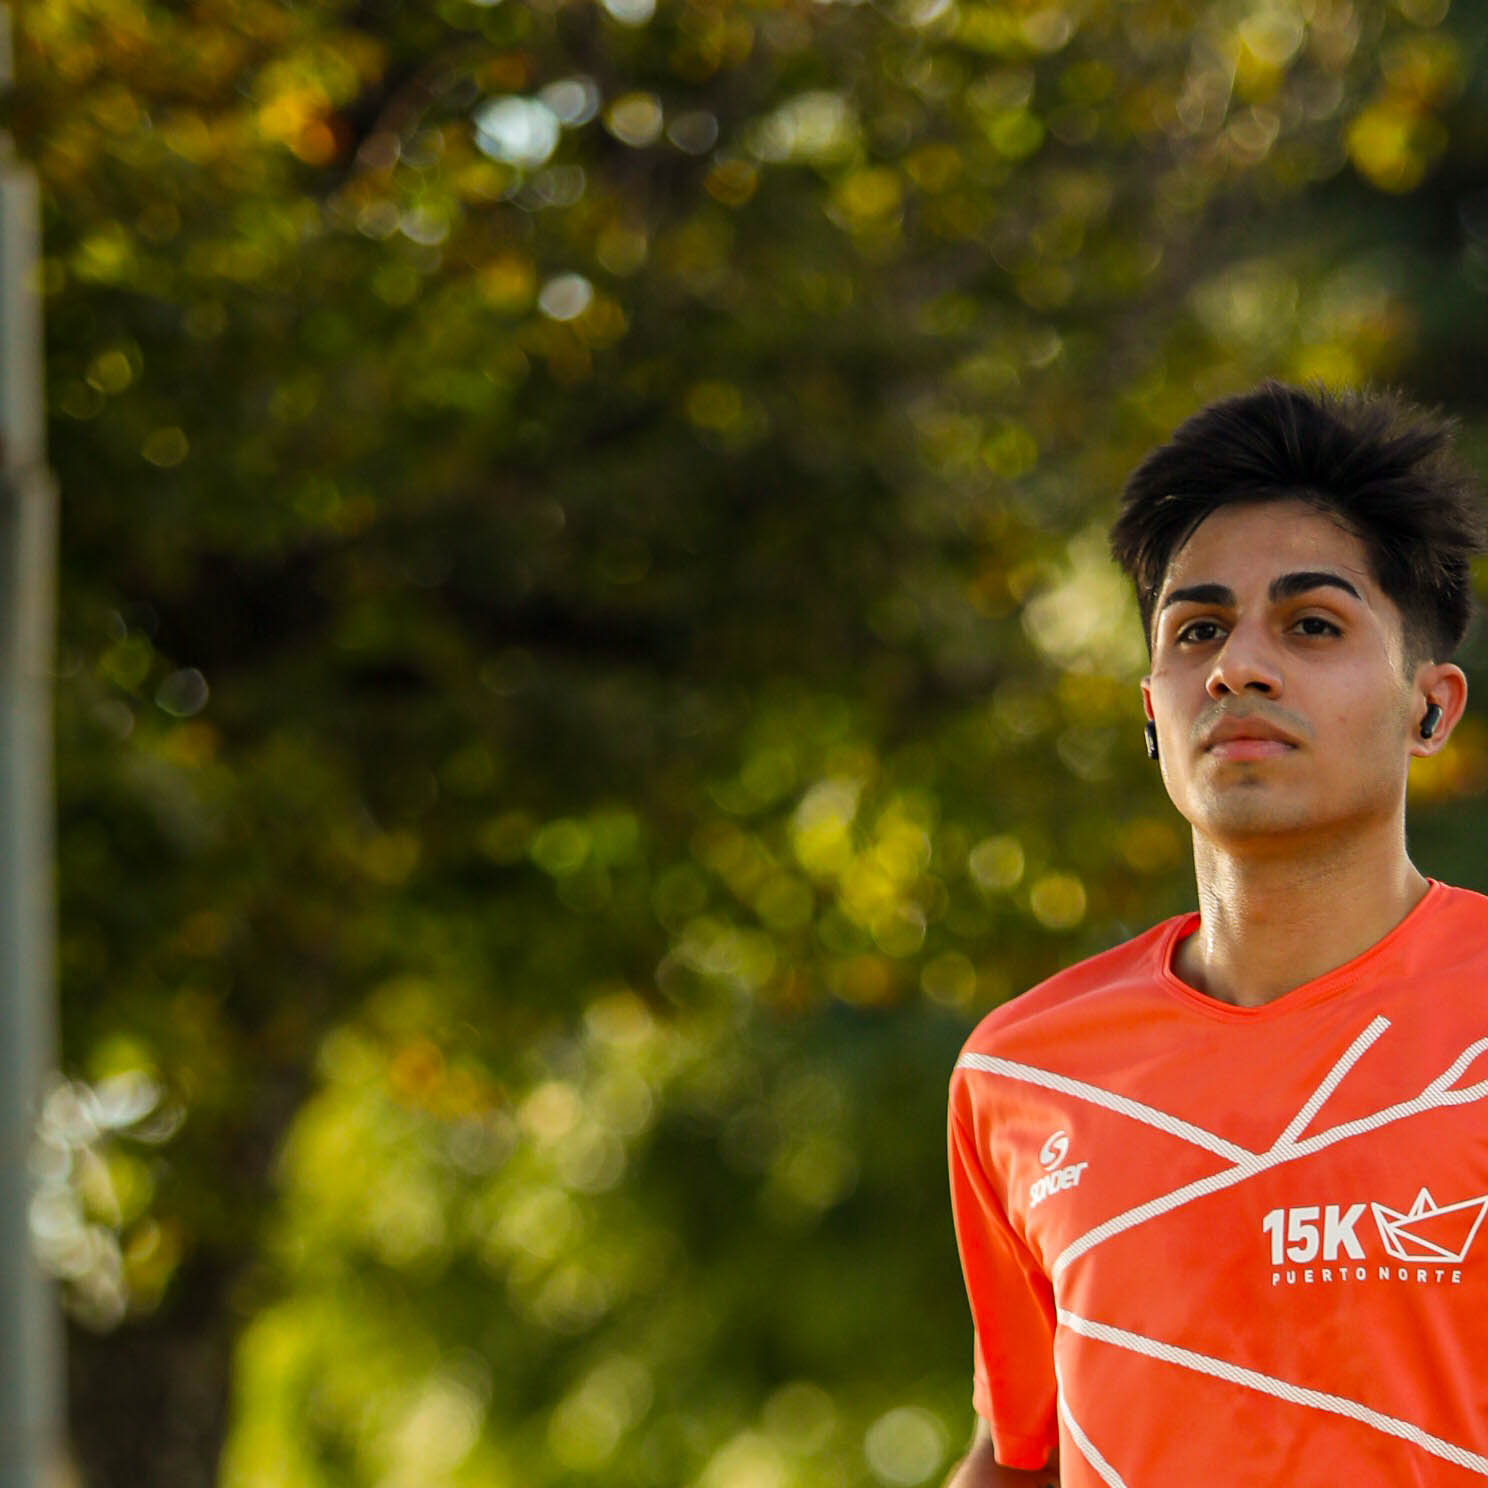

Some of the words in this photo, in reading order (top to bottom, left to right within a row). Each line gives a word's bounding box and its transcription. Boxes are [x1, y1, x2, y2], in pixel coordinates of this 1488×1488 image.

[1262, 1203, 1367, 1266] 15K
[1272, 1267, 1367, 1287] PUERTO
[1379, 1266, 1463, 1284] NORTE
